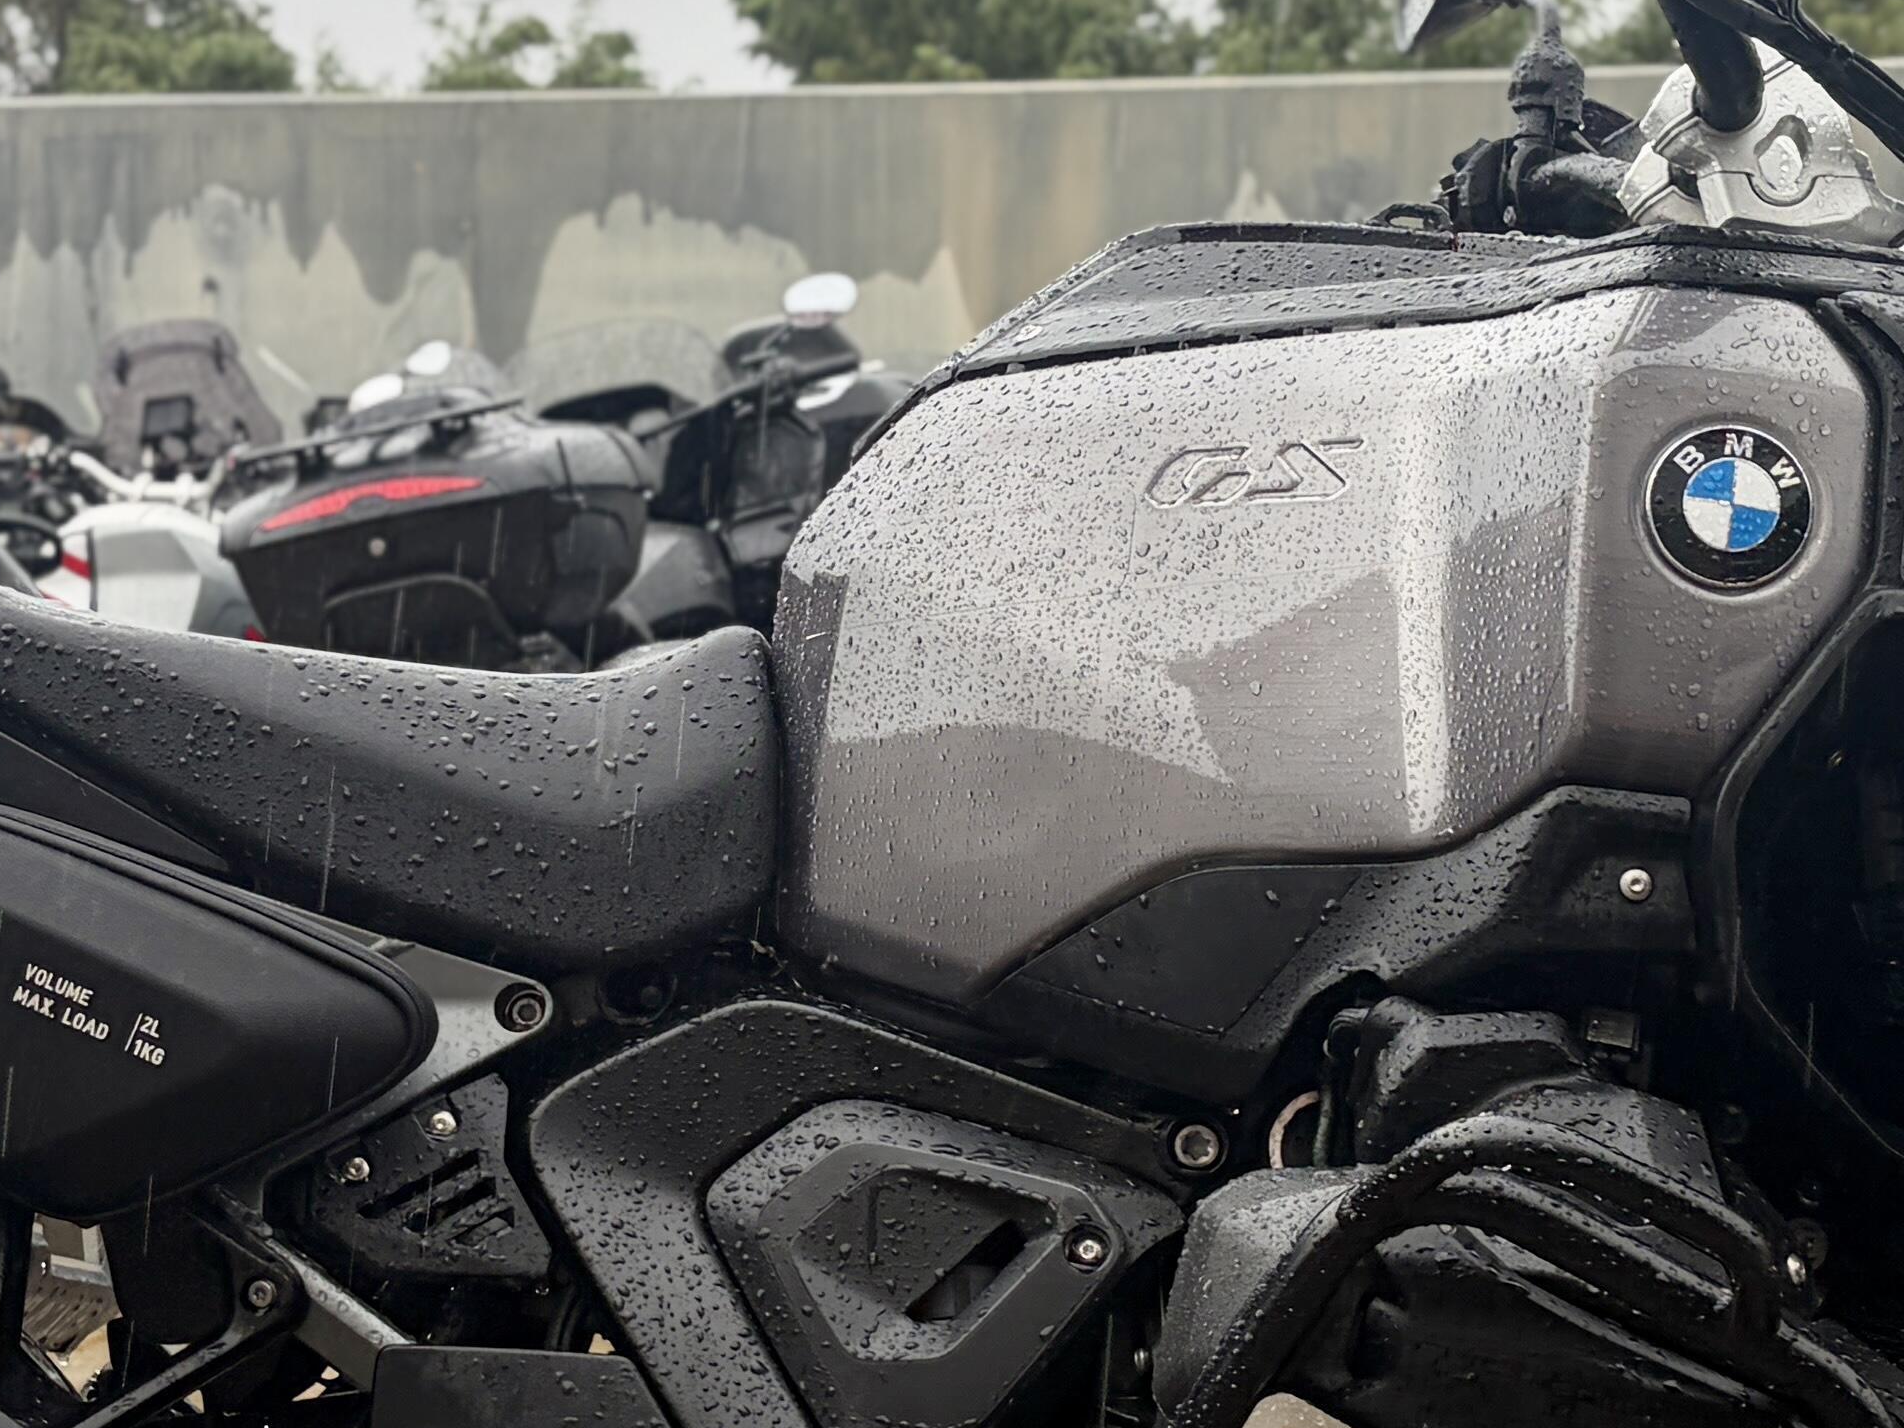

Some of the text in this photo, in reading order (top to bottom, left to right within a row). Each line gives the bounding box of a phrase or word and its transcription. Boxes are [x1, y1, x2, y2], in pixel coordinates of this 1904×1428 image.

[1672, 432, 1802, 489] BMW
[24, 963, 94, 1007] VOLUME
[12, 985, 110, 1041] MAX. LOAD
[139, 1015, 160, 1039] 2L
[132, 1038, 166, 1066] 1KG
